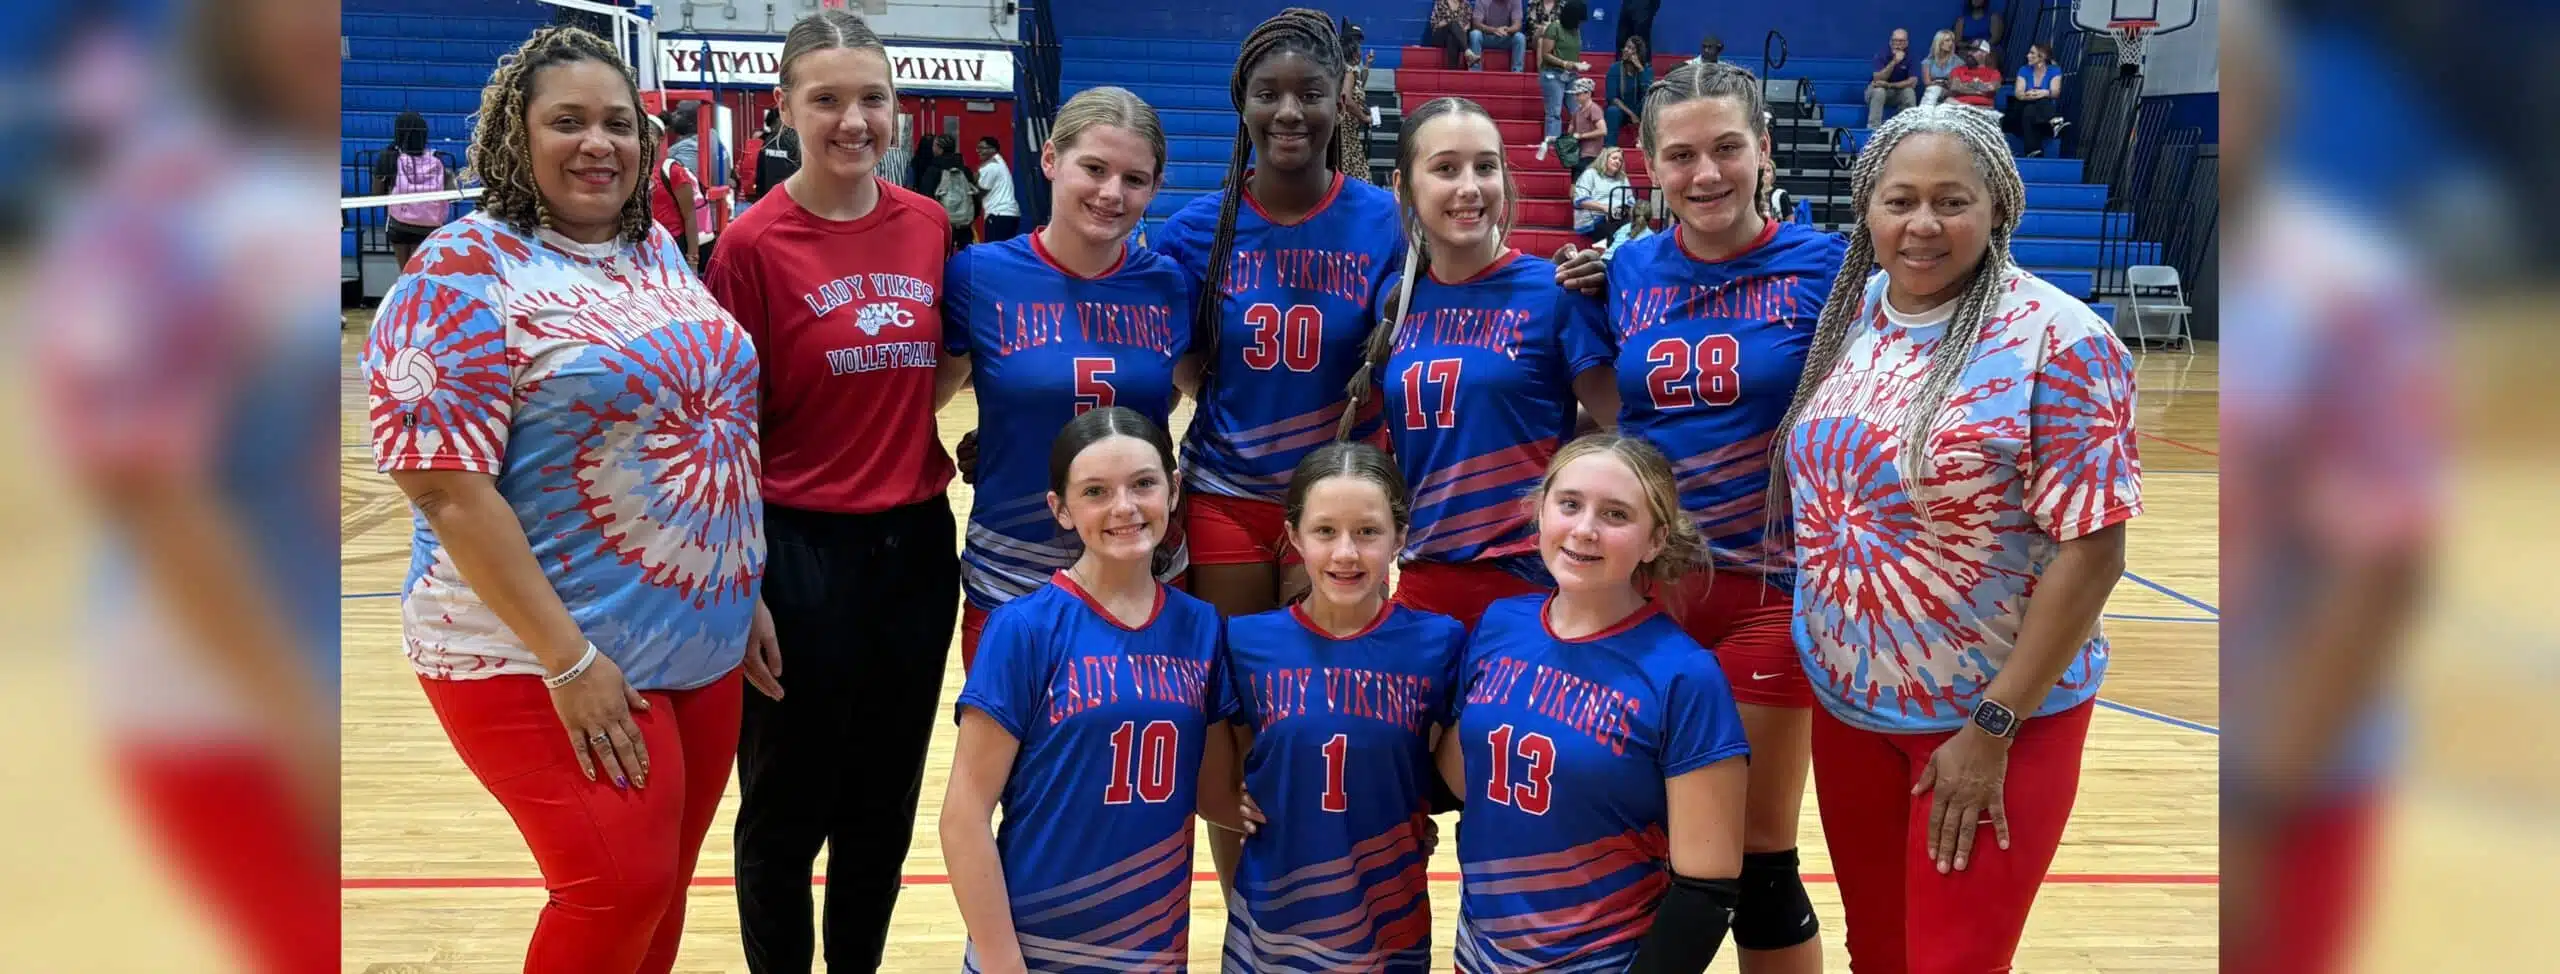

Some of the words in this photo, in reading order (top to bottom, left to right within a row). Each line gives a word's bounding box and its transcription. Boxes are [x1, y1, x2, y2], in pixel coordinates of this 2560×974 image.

[804, 275, 866, 317] LADY
[869, 273, 934, 307] VIKES
[1221, 250, 1266, 294] ADY
[1276, 248, 1370, 309] VIKINGS
[1619, 284, 1681, 345] LADY
[1687, 275, 1799, 330] VIKINGS
[826, 341, 937, 376] VOLLEYBALL
[995, 301, 1065, 356] LADY
[1075, 301, 1173, 358] VIKINGS
[1243, 302, 1323, 373] 30
[1391, 311, 1428, 356] DY
[1433, 307, 1530, 361] VIKINGS
[1073, 357, 1117, 416] 5
[1401, 357, 1463, 430] 17
[1646, 333, 1741, 410] 28
[552, 668, 579, 685] COACH
[1048, 655, 1119, 728] LADY
[1127, 654, 1212, 713] VIKING
[1250, 667, 1312, 736] LADY
[1323, 666, 1432, 737] VIKINGS
[1526, 664, 1641, 758] VIKINGS
[1104, 720, 1178, 804] 10
[1321, 733, 1347, 813] 1
[1486, 723, 1557, 816] 13
